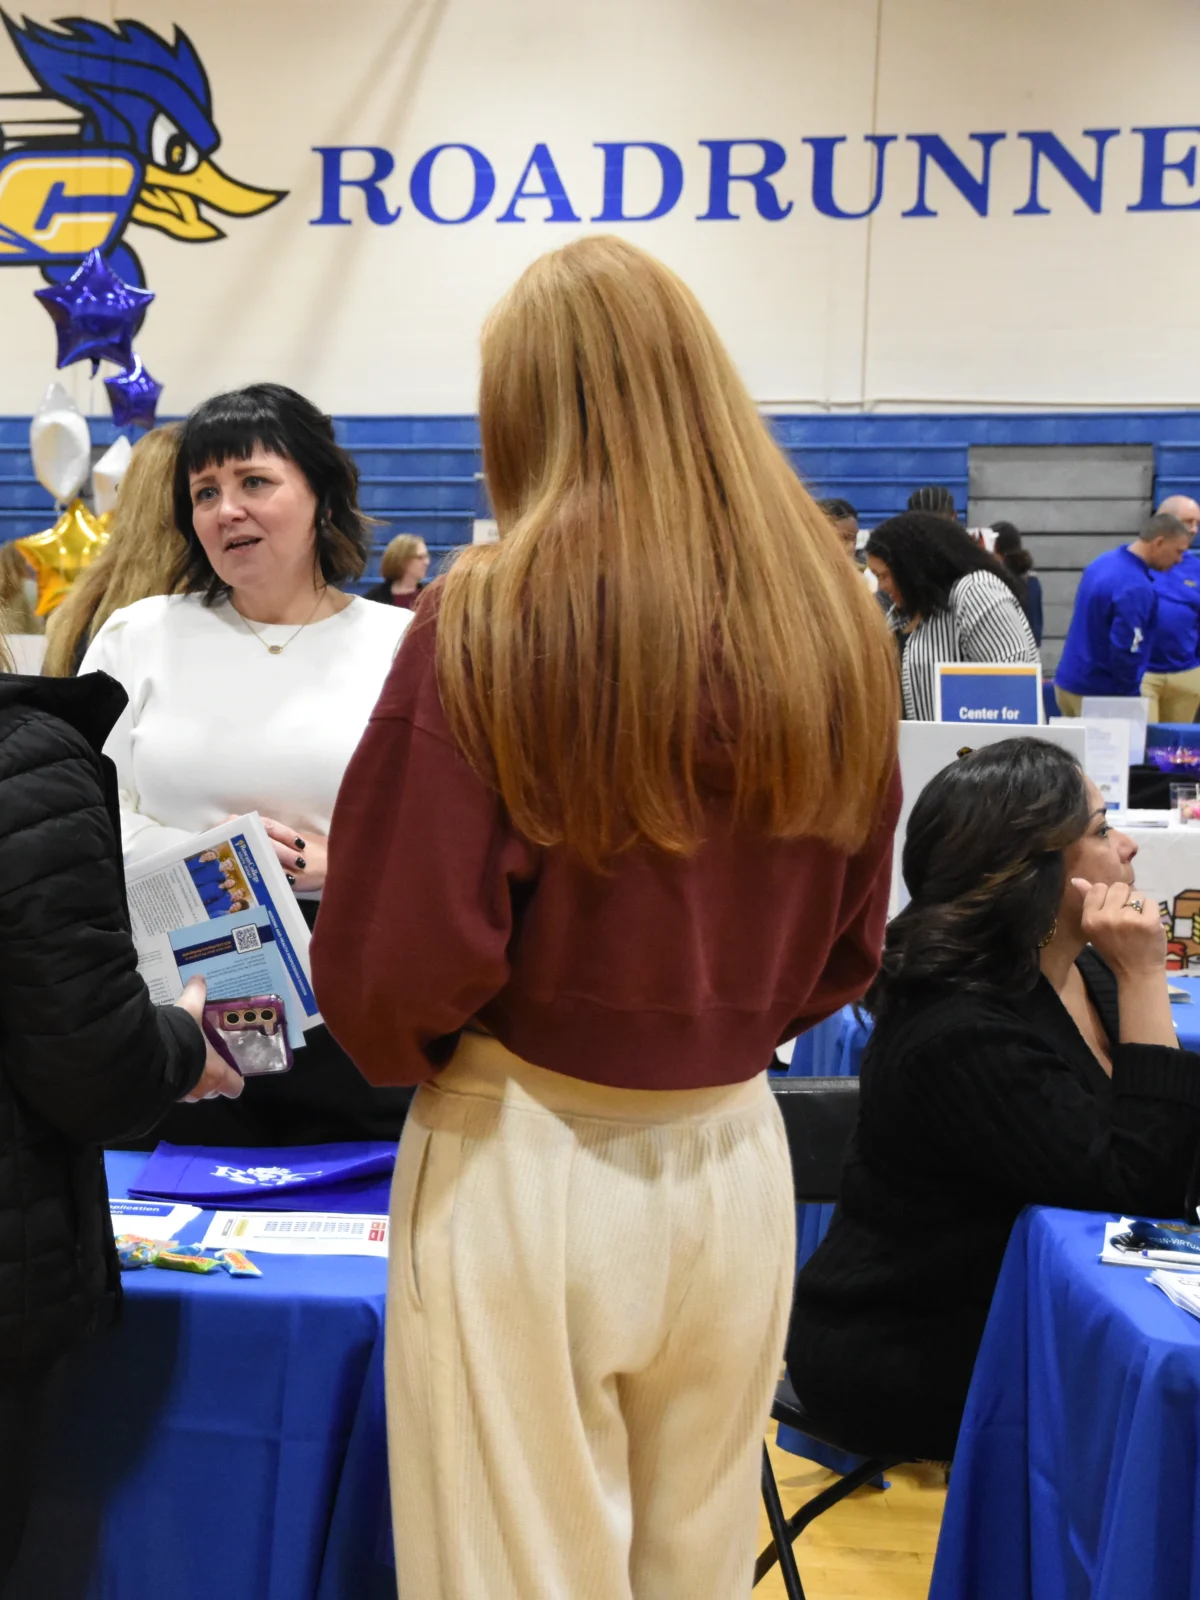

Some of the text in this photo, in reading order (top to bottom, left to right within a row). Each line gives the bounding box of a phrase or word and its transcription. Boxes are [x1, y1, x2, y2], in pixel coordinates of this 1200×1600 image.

[309, 126, 1200, 226] ROADRUNNE
[959, 706, 1020, 720] Center for
[239, 844, 262, 884] Rowan College
